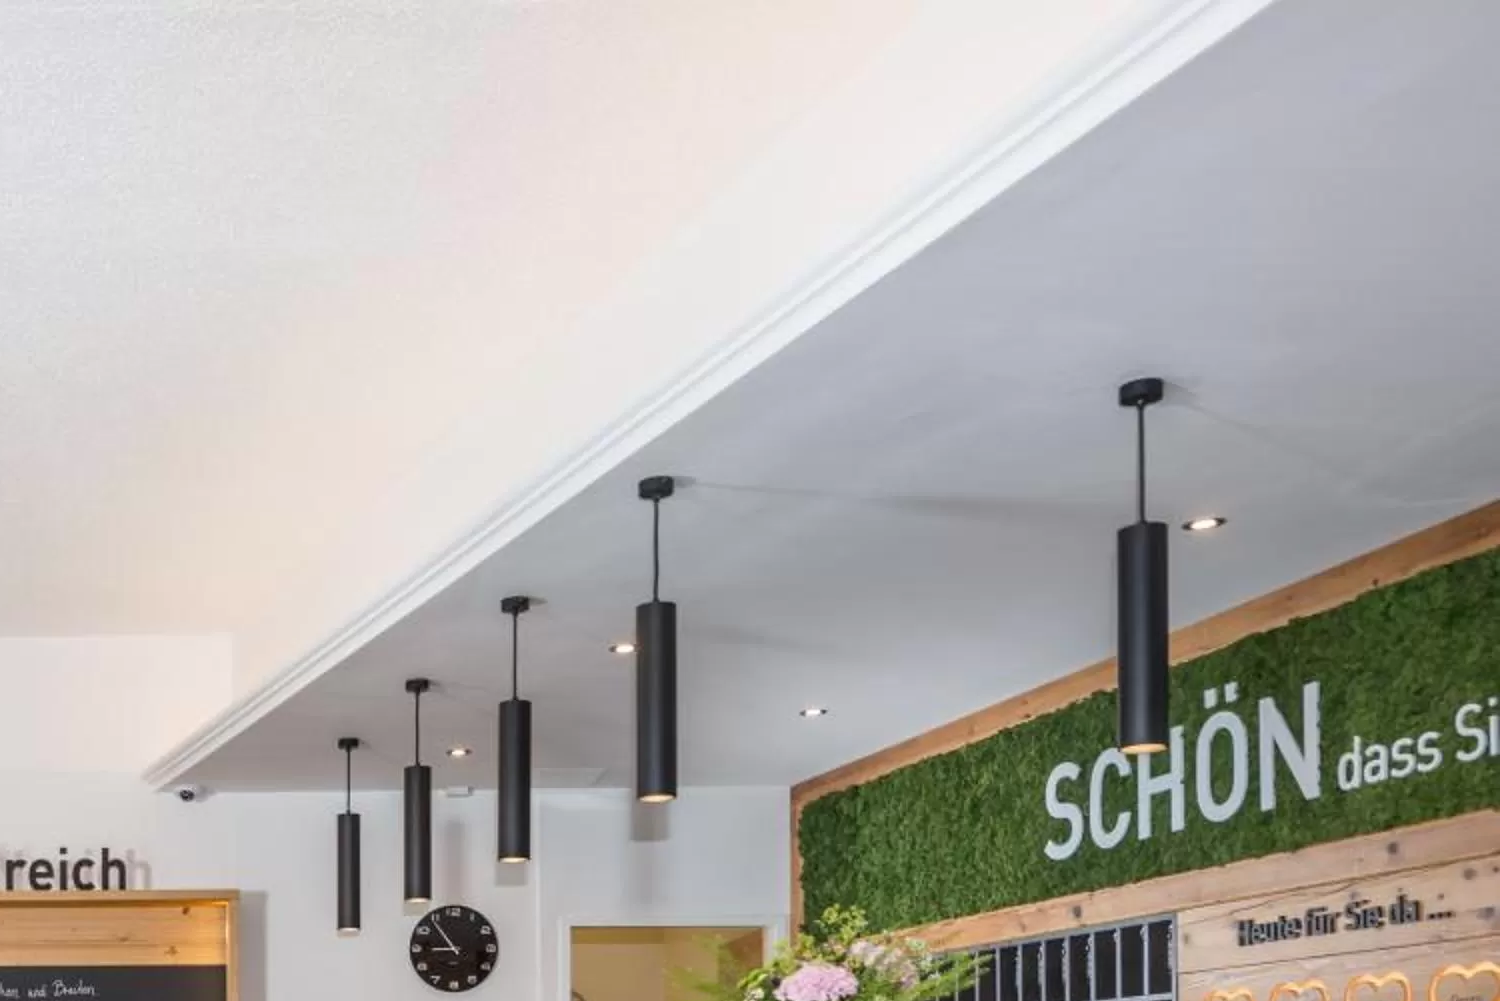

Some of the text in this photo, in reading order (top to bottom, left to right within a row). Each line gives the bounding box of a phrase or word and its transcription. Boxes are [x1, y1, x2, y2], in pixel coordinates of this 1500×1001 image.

[1044, 681, 1500, 861] SCHÖN dass Si
[1236, 915, 1301, 947] Heute
[1304, 905, 1342, 937] für
[1345, 899, 1385, 931] Sie
[1389, 893, 1423, 925] da
